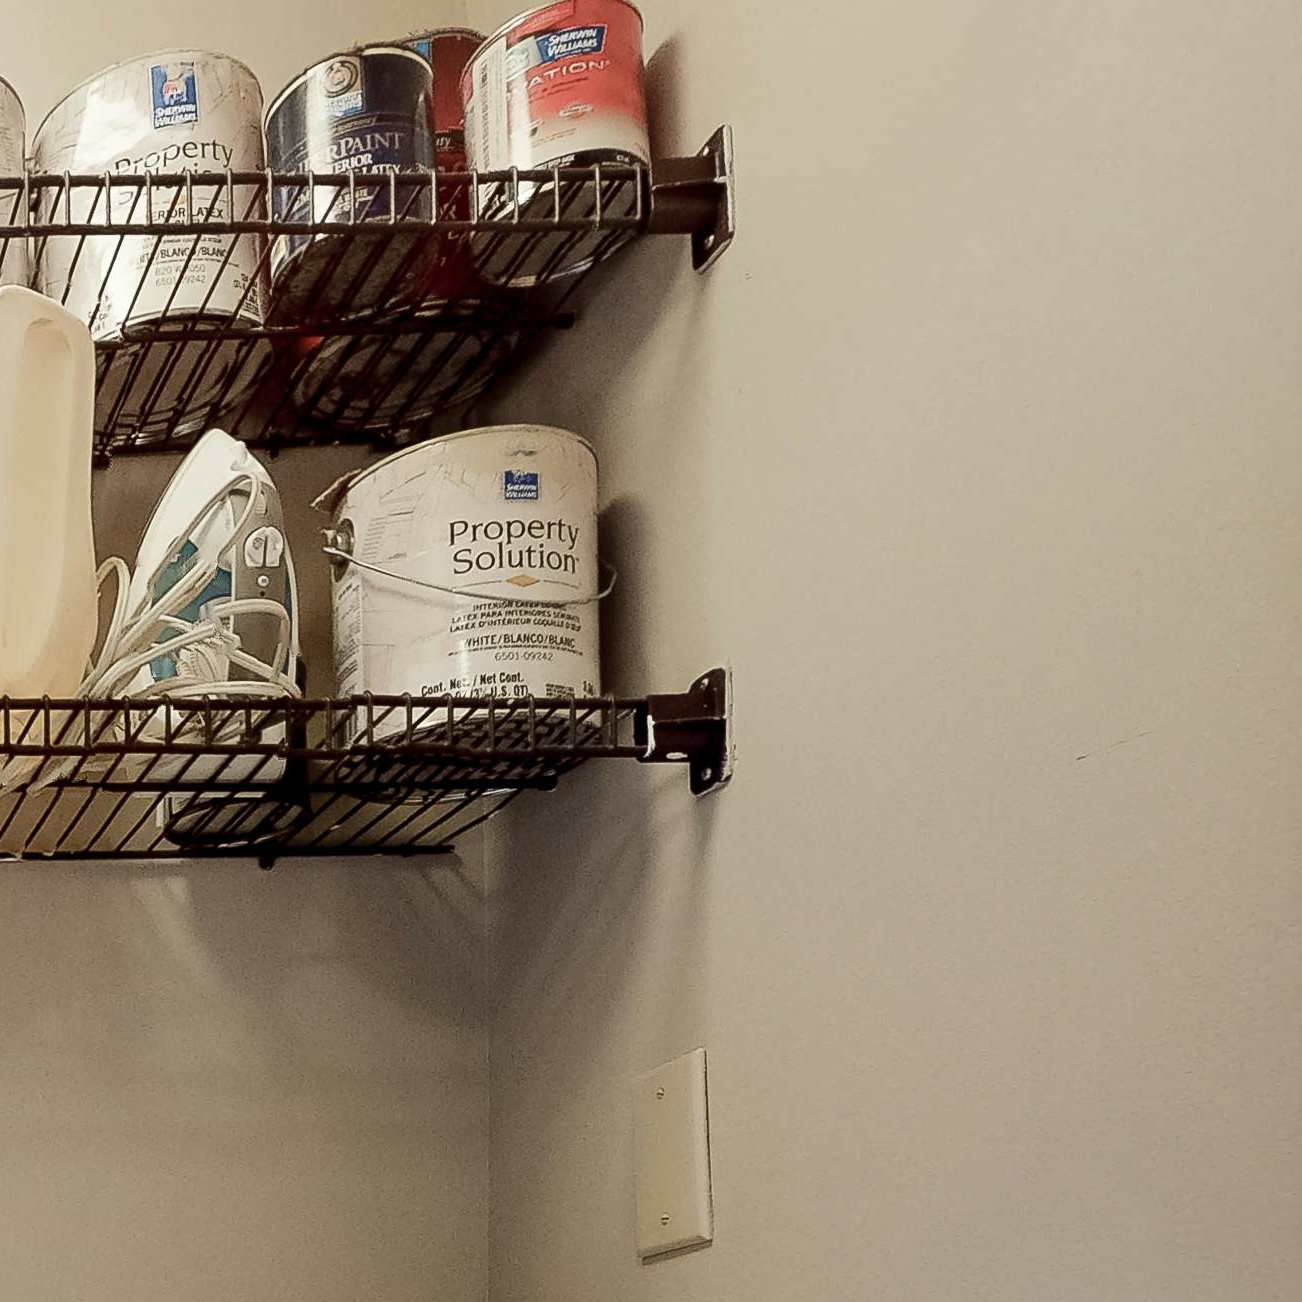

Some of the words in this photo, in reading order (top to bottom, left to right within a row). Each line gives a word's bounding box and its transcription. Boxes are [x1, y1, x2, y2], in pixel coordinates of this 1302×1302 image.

[548, 28, 597, 45] SHERWIN
[547, 39, 599, 57] WILLIAMS
[155, 104, 197, 116] SHERWIN
[114, 139, 233, 175] Property
[449, 518, 580, 551] Property
[452, 542, 580, 575] Solution
[451, 612, 478, 625] LATEX
[480, 610, 503, 619] PARA
[504, 609, 552, 619] INTERIORES
[449, 622, 476, 634] LATEX
[421, 681, 447, 697] Cont.
[479, 673, 497, 686] Net
[499, 671, 525, 683] Cont.
